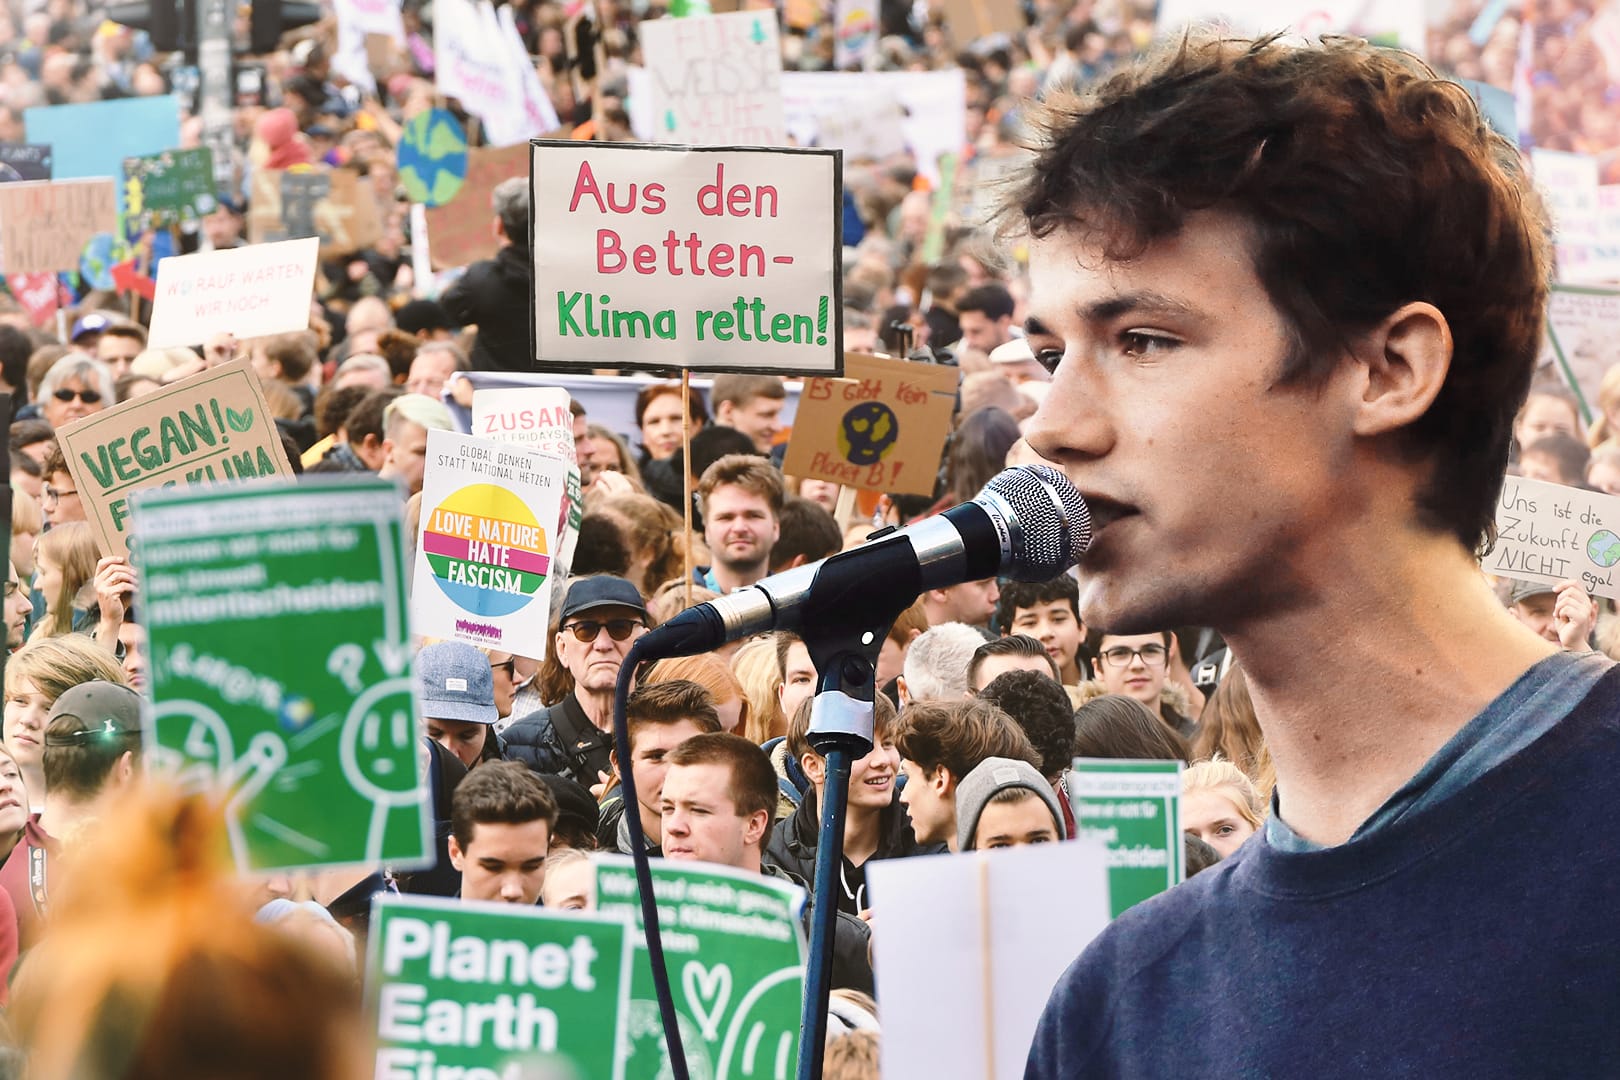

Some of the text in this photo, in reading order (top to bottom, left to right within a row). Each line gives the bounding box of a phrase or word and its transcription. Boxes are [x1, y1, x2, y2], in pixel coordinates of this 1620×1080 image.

[568, 160, 666, 214] Aus
[697, 162, 778, 218] den
[597, 229, 794, 277] Betten-
[242, 262, 305, 285] WARTEN
[194, 293, 272, 318] WIR NOCH
[557, 290, 829, 346] Klima retten!
[80, 398, 230, 489] VEGAN!
[460, 444, 492, 463] GLOBAL
[497, 452, 532, 470] DENKEN
[438, 454, 551, 488] STATT NATIONAL HETZEN
[1502, 483, 1603, 526] Uns ist die
[435, 510, 540, 549] LOVE NATURE
[1498, 515, 1580, 550] Zukunft
[468, 540, 511, 568] HATE
[1497, 546, 1571, 577] NICHT
[447, 560, 522, 595] FASCISM
[1581, 570, 1614, 593] egal
[382, 915, 599, 992] Planet
[377, 982, 560, 1052] Earth
